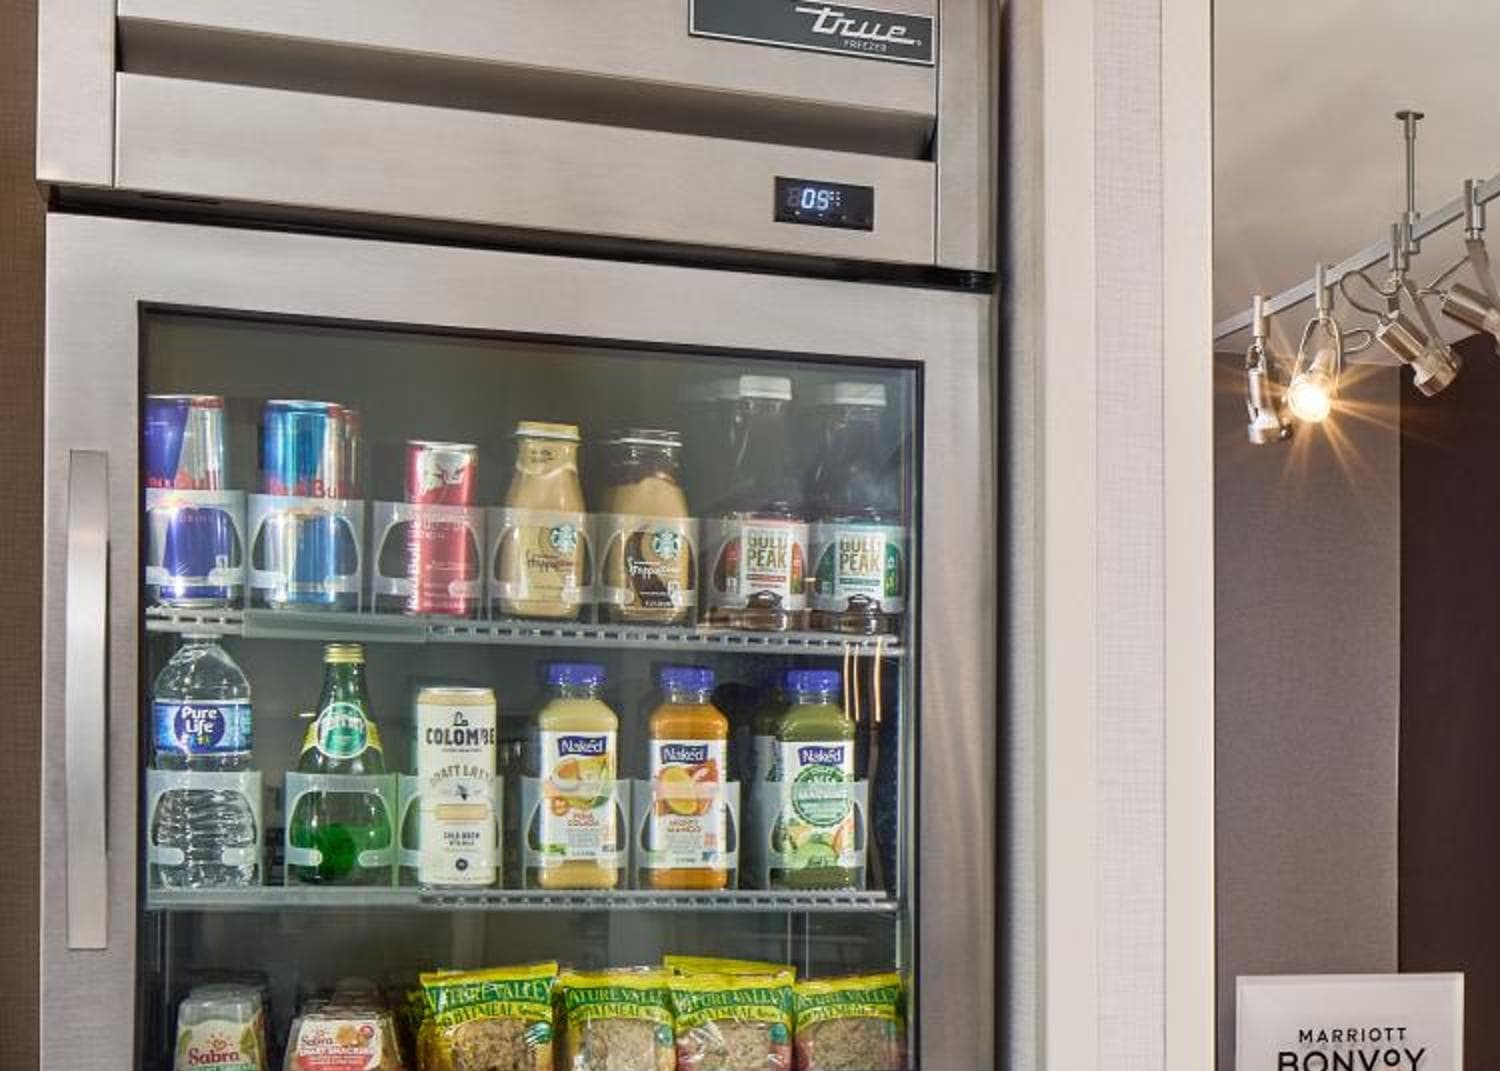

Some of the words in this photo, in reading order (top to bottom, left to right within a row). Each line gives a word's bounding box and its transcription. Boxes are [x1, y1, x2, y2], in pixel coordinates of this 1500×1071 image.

[795, 6, 915, 45] true
[747, 548, 787, 569] PEAK
[839, 553, 881, 572] PEAK
[181, 705, 218, 720] Pure
[185, 719, 215, 736] Life
[425, 727, 496, 747] COLOMBE
[561, 738, 604, 754] Naked
[662, 746, 705, 763] Naked
[801, 748, 843, 764] Naked
[497, 977, 557, 1001] VALLEY
[1298, 1027, 1407, 1043] MARRIOTT
[187, 1047, 241, 1067] Sabra
